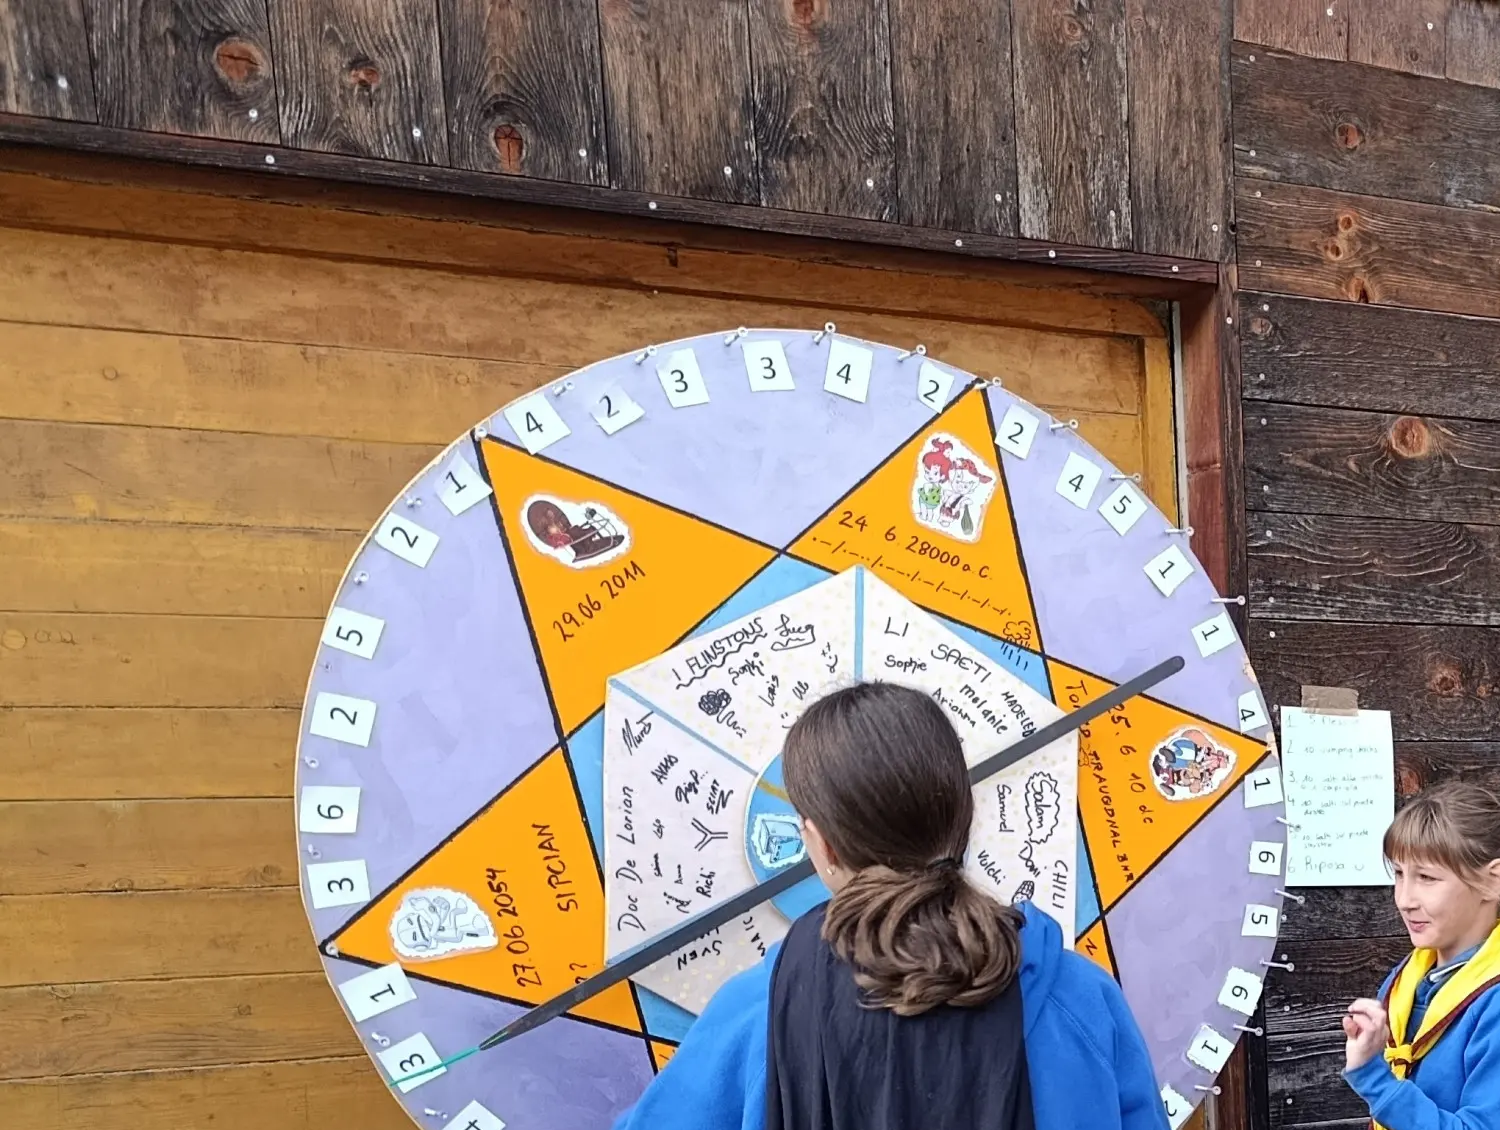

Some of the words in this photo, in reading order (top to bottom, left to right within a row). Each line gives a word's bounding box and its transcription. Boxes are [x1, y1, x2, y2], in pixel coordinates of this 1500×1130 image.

[763, 357, 776, 380] 3
[836, 363, 851, 385] 4
[670, 369, 689, 393] 3
[923, 379, 940, 403] 2
[601, 395, 618, 418] 2
[525, 411, 543, 433] 4
[1007, 422, 1024, 445] 2
[446, 471, 467, 494] 1
[1068, 474, 1084, 493] 4
[1113, 495, 1132, 514] 5
[390, 526, 419, 548] 2
[600, 560, 646, 599] 2011
[1158, 560, 1175, 579] 1
[335, 626, 363, 646] 5
[1201, 624, 1220, 641] 1
[329, 707, 358, 725] 2
[1240, 708, 1256, 722] 4
[1253, 777, 1271, 790] 1
[615, 859, 643, 884] De
[327, 877, 354, 893] 3
[486, 868, 519, 917] 2054
[617, 895, 646, 931] Doc
[1251, 912, 1268, 925] 5
[369, 983, 396, 1002] 1
[1201, 1040, 1219, 1054] 1
[399, 1053, 425, 1073] 3
